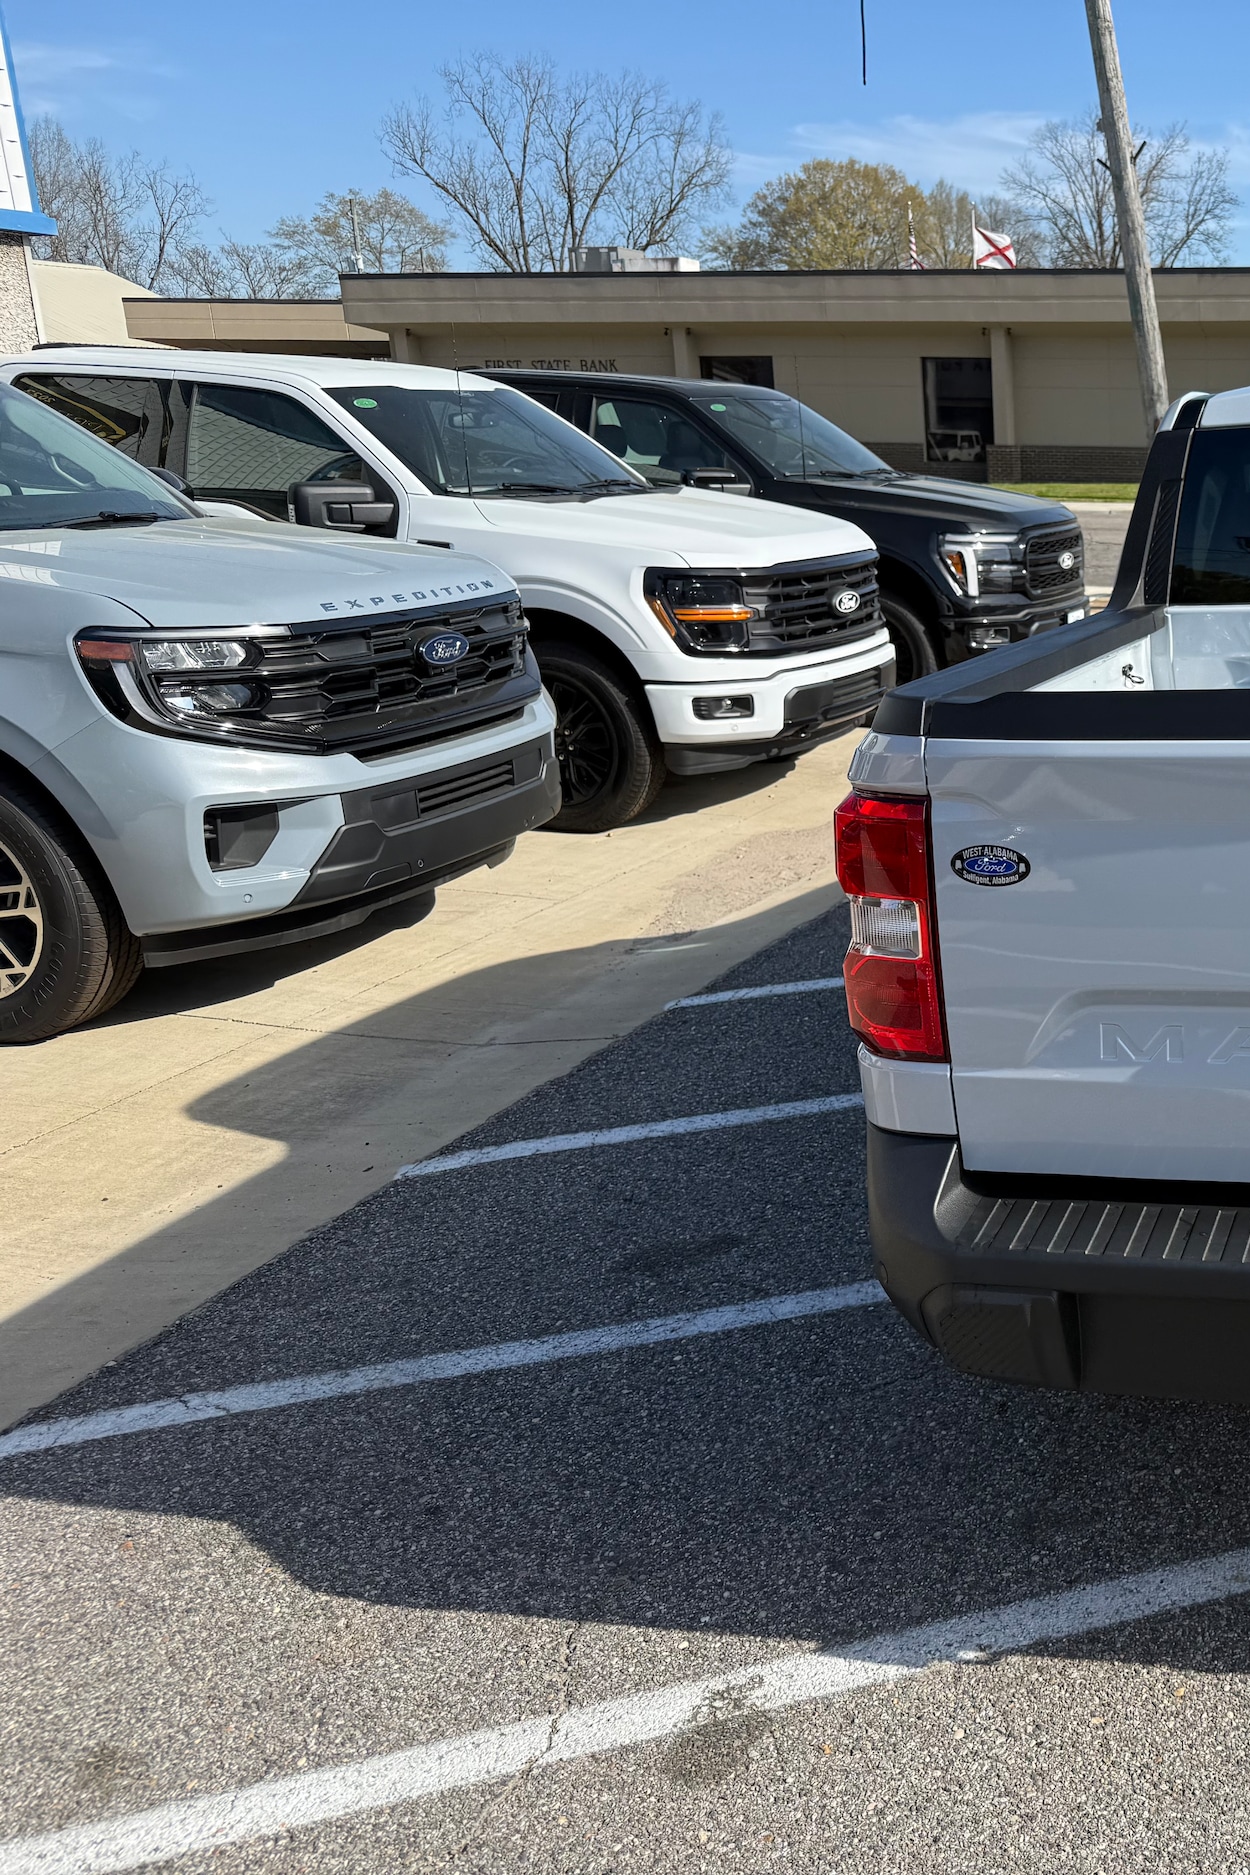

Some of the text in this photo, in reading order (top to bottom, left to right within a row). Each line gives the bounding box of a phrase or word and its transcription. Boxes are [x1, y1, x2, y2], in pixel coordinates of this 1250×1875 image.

[484, 359, 618, 372] FIRST STATE BANK
[319, 579, 495, 613] EXPEDITION
[432, 638, 462, 660] Ford
[962, 846, 1018, 862] WEST ALABAMA
[975, 857, 1006, 873] Ford
[992, 874, 1019, 885] Alabama
